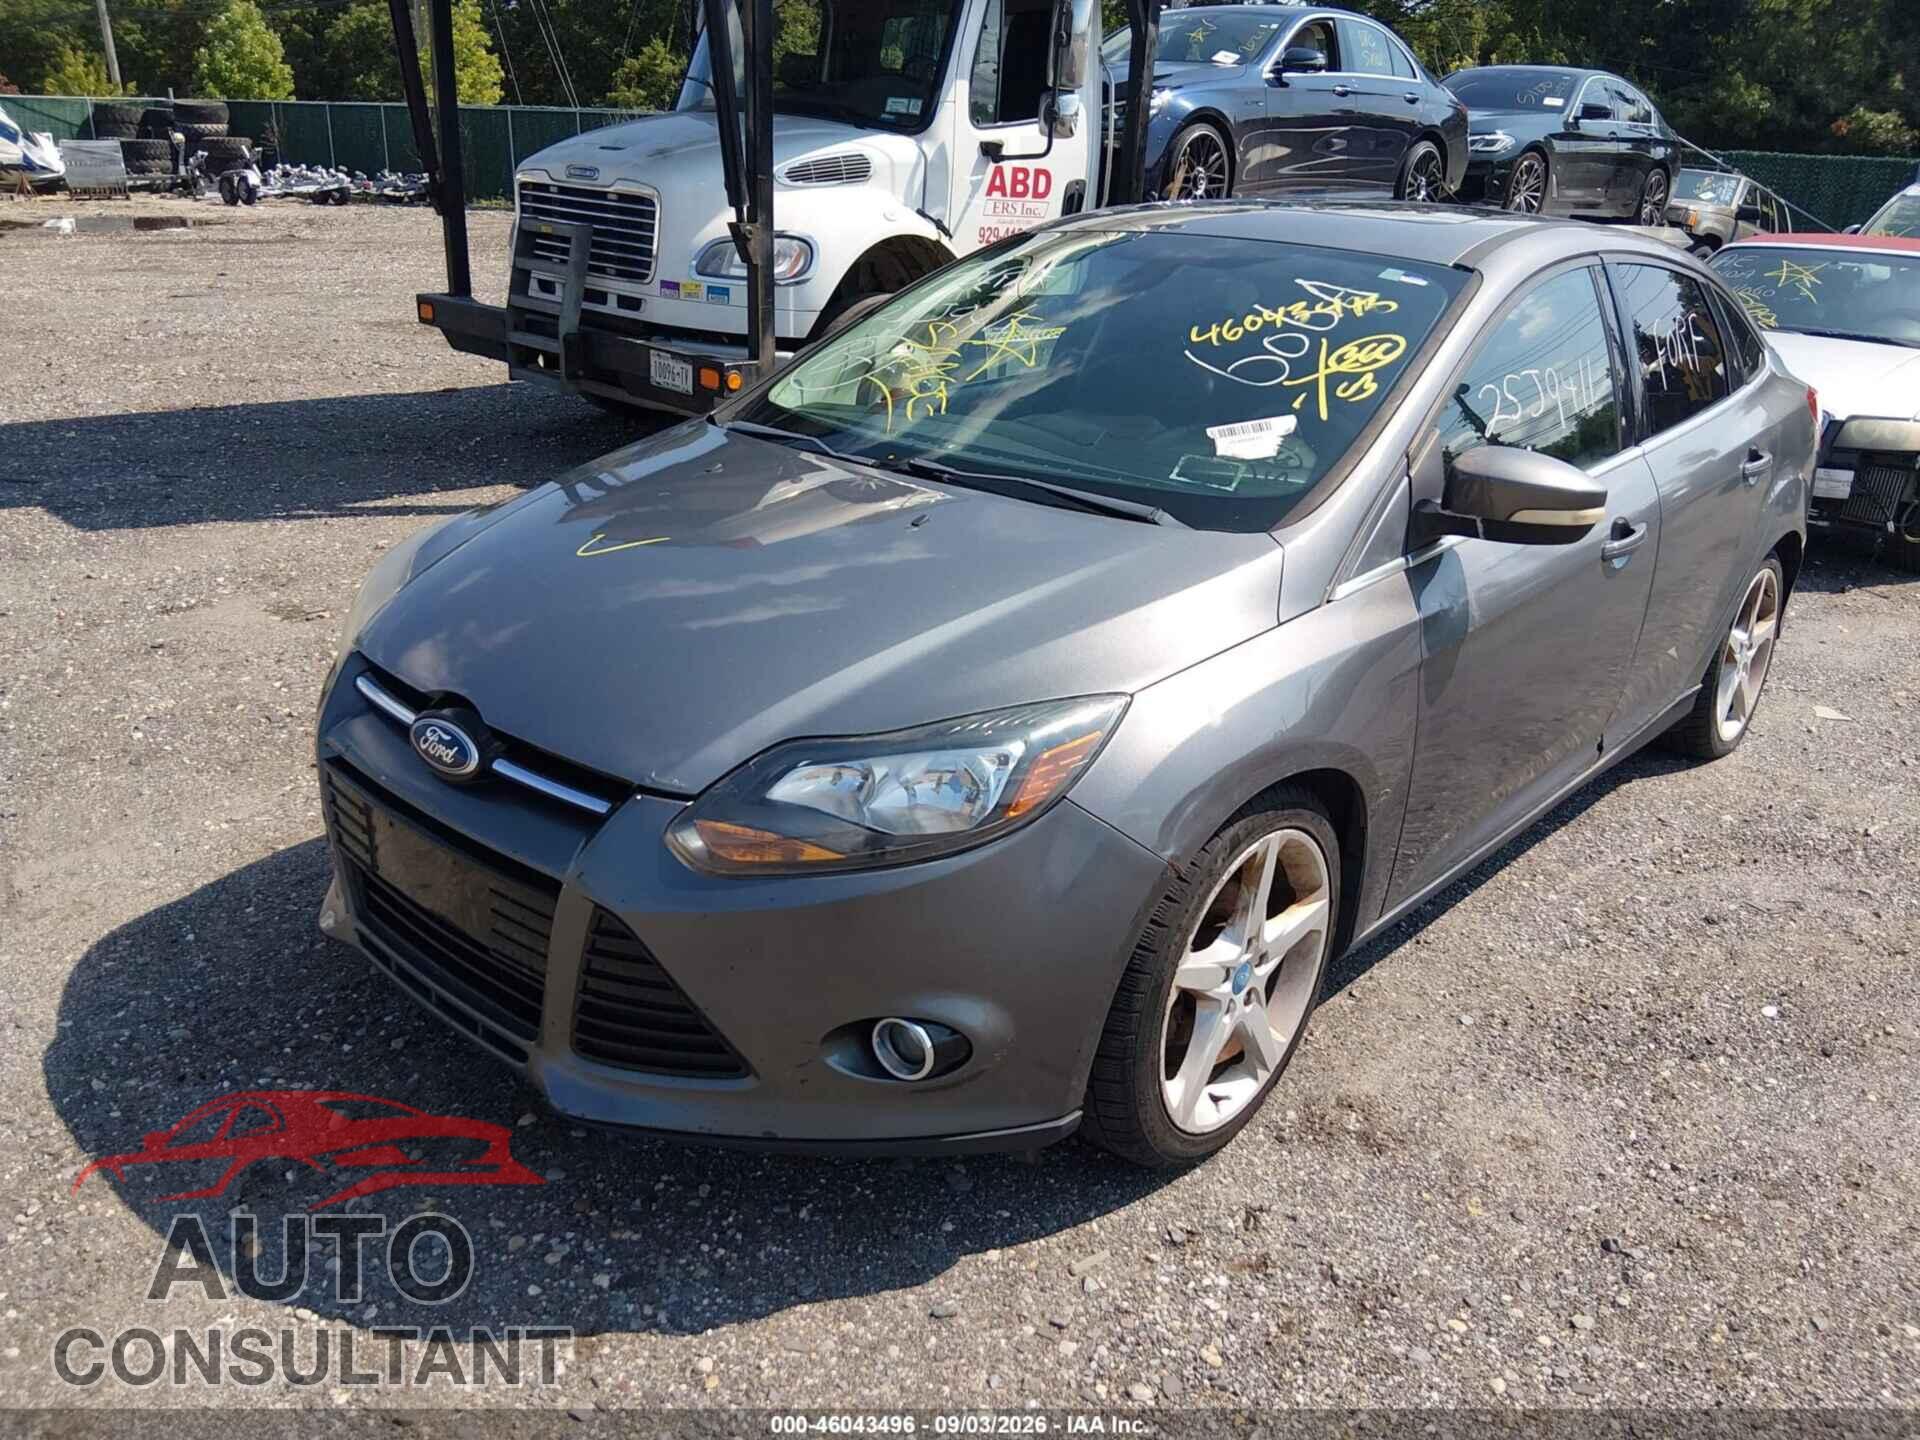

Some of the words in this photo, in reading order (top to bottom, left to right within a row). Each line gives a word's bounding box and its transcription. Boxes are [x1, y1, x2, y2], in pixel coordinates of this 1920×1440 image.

[985, 165, 1052, 199] ABD
[992, 201, 1017, 215] ERS
[1020, 202, 1041, 216] Inc.
[420, 726, 459, 763] Ford
